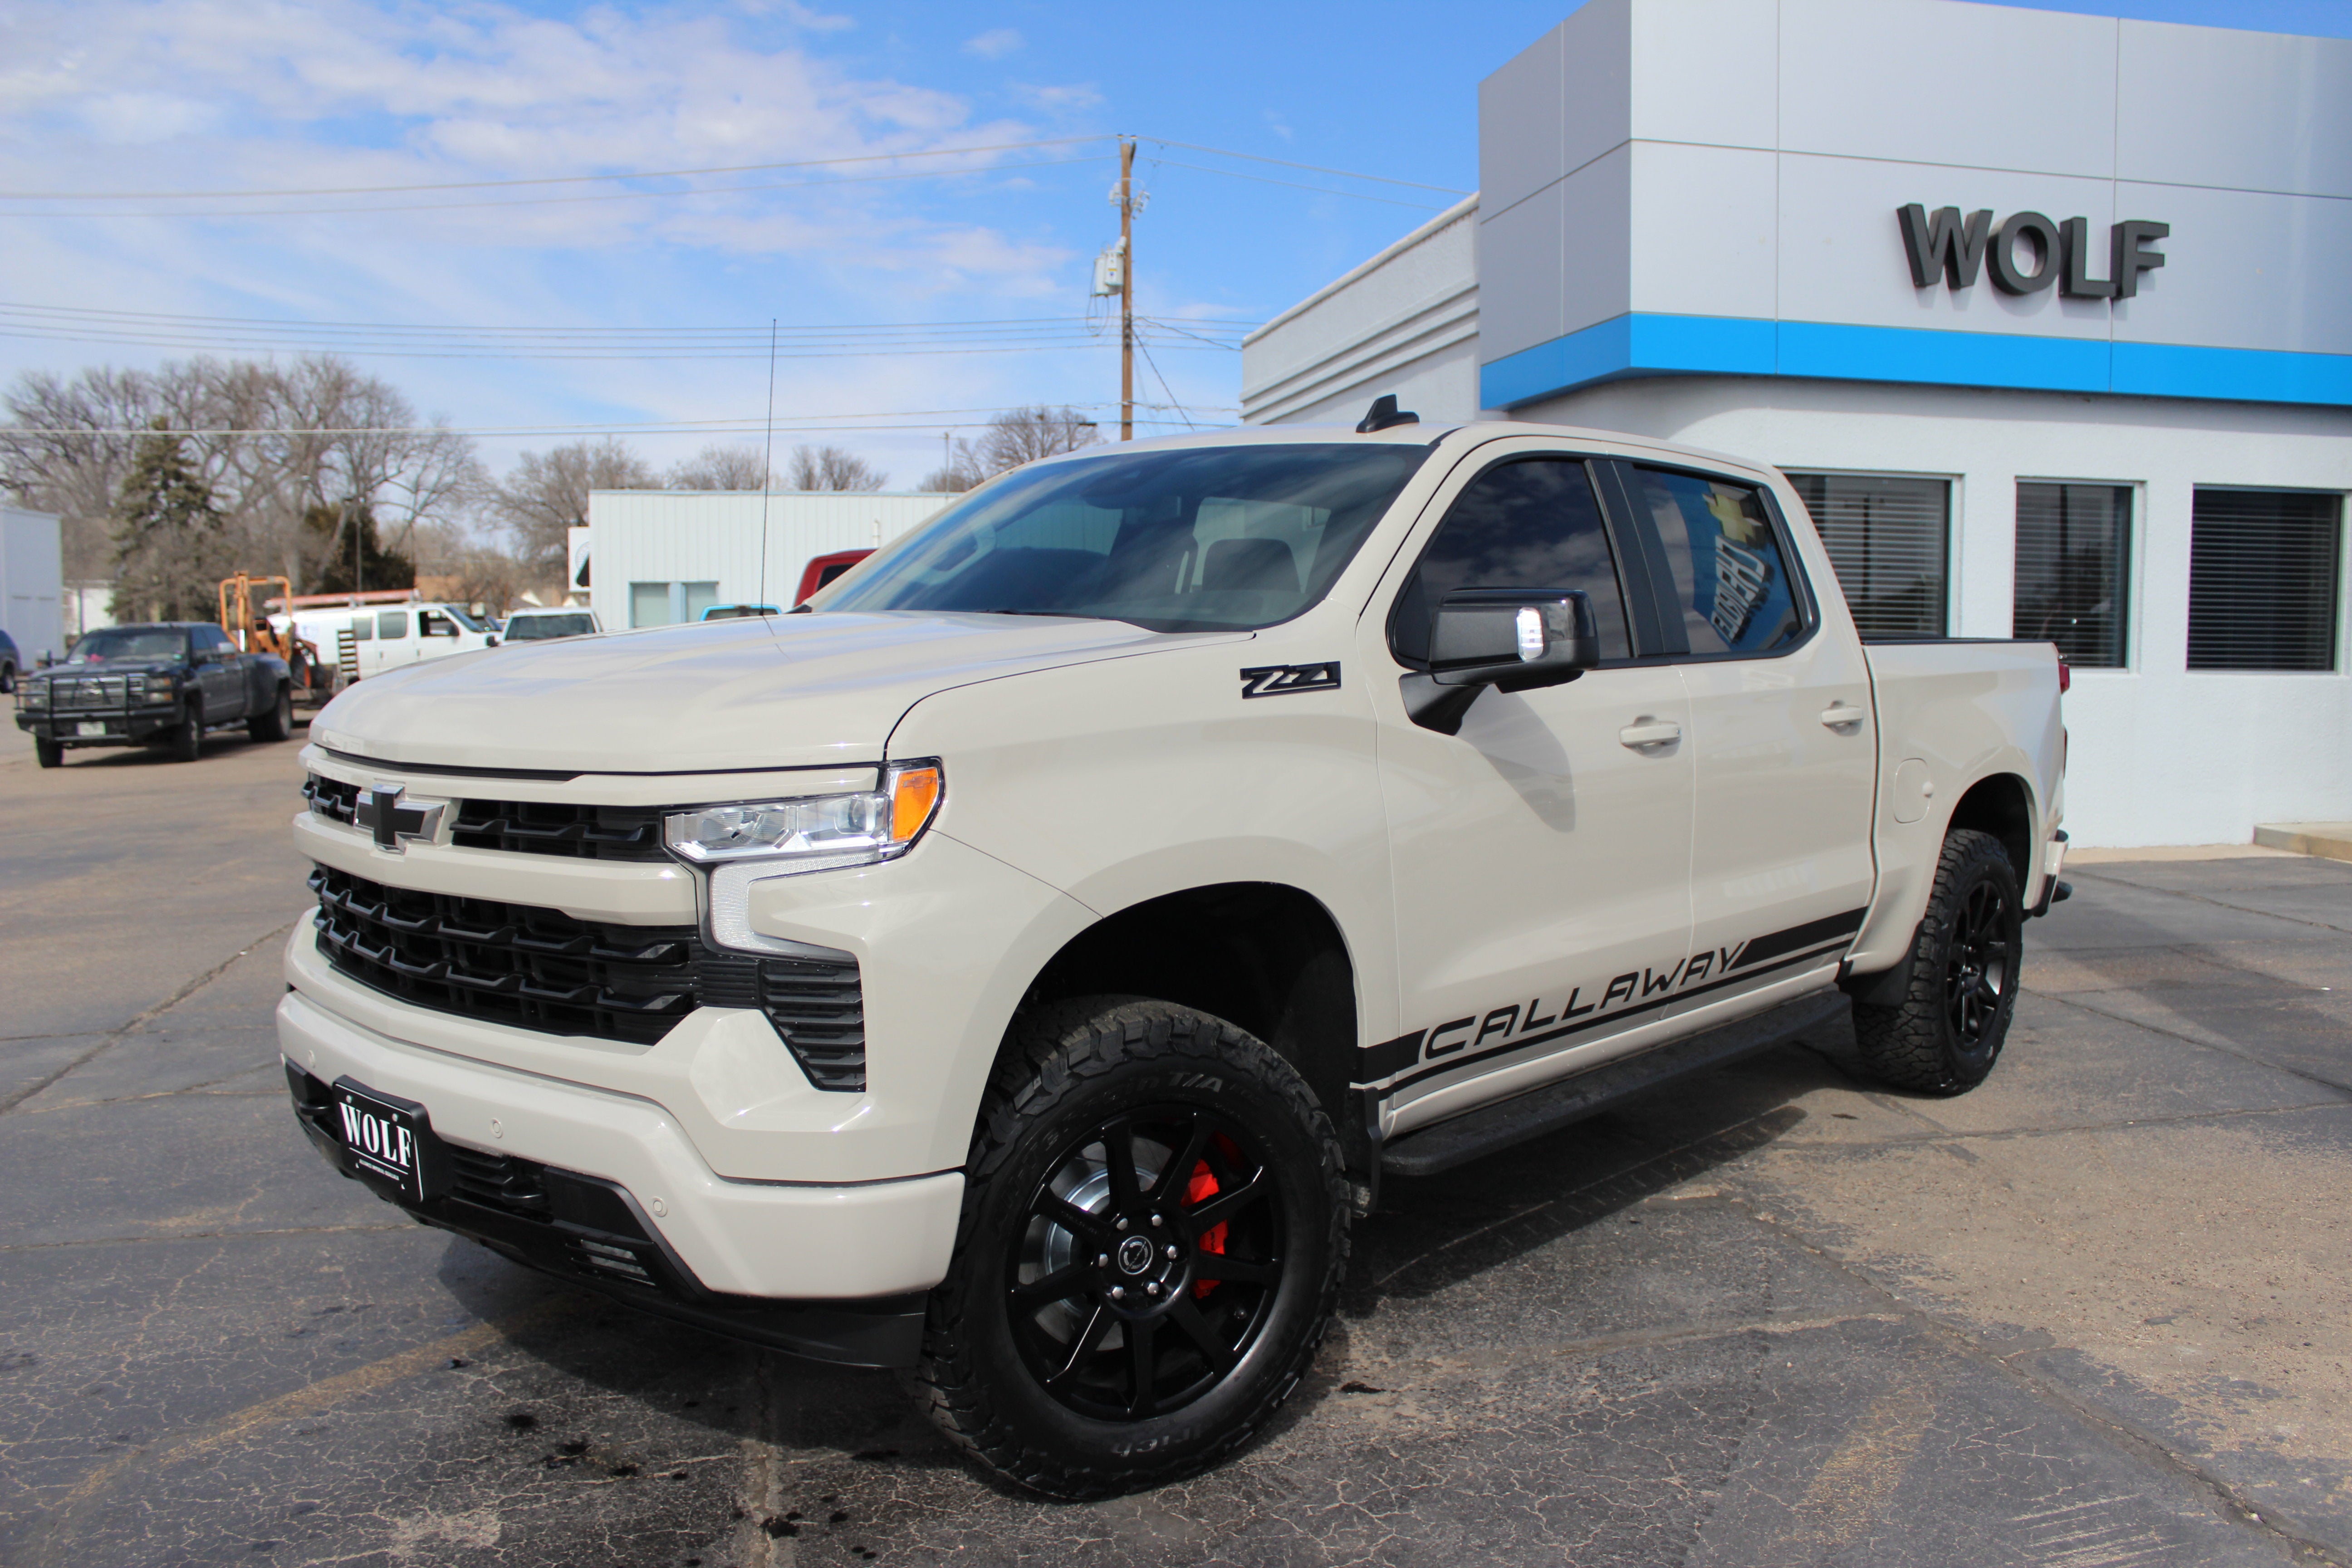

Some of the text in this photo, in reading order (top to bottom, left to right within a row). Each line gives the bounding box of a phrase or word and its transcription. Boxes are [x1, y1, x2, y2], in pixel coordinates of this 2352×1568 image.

[1896, 203, 2170, 300] WOLF
[1240, 661, 1341, 699] Z71
[1424, 941, 1746, 1059] CALLAWAY
[1168, 1071, 1224, 1093] T/A
[339, 1102, 412, 1167] WOLF
